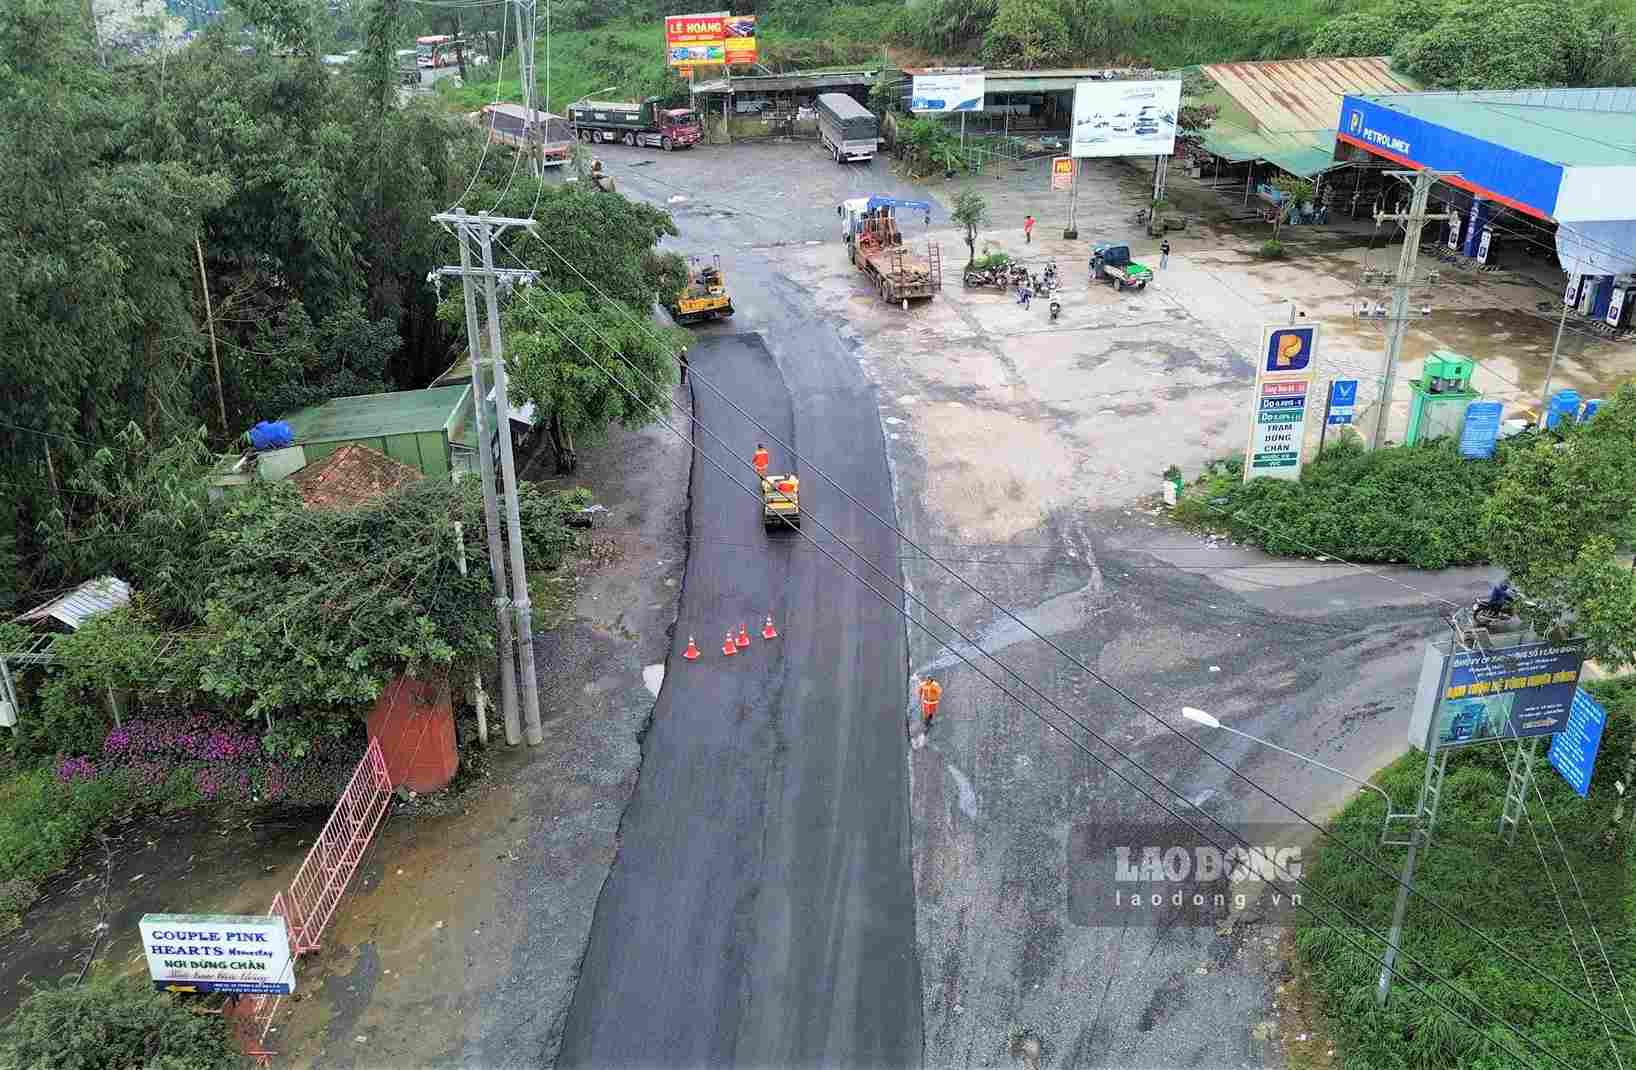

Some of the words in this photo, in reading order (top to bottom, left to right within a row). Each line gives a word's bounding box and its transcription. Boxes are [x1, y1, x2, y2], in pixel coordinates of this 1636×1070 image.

[1362, 127, 1410, 154] PETROLIMEX
[152, 930, 220, 941] COUPLE
[226, 931, 268, 942] PINK
[151, 945, 224, 956] HEARTS
